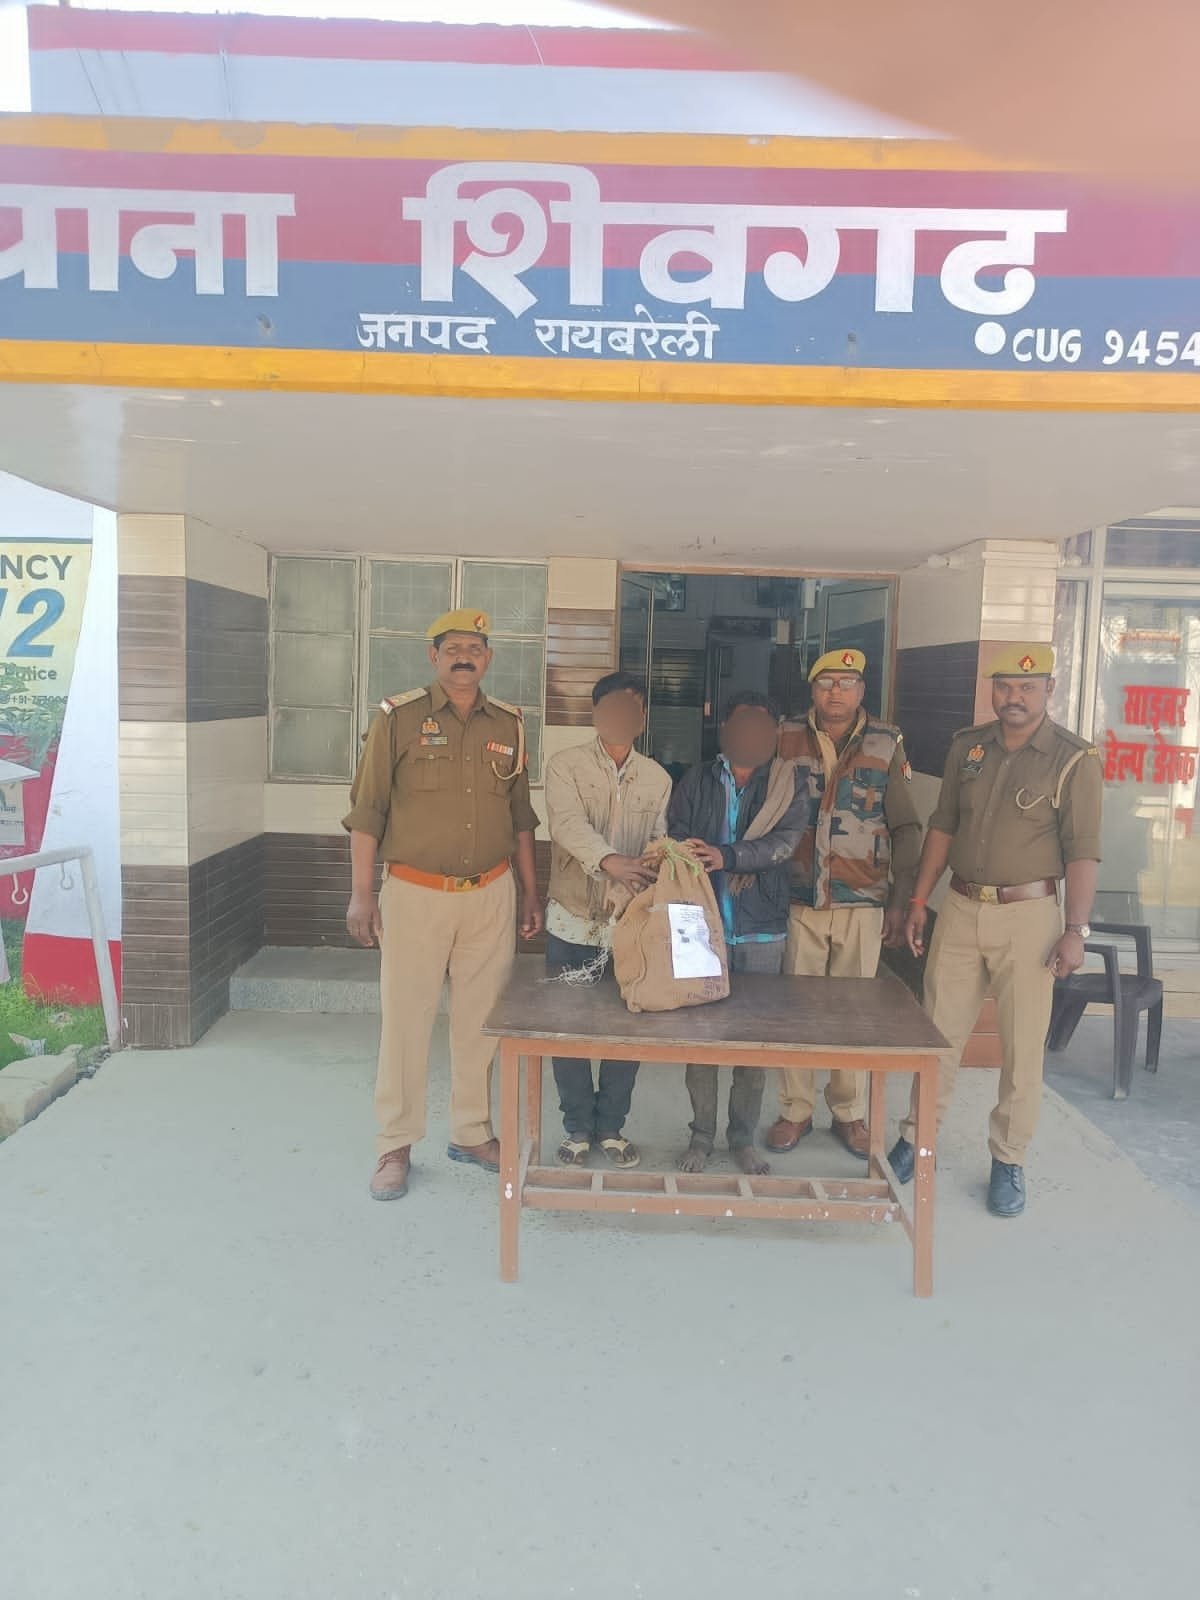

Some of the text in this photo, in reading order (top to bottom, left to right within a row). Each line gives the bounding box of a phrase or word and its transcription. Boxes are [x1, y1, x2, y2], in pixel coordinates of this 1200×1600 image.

[356, 303, 721, 359] जनपद रायबरेली
[1012, 328, 1200, 366] CUG 9454
